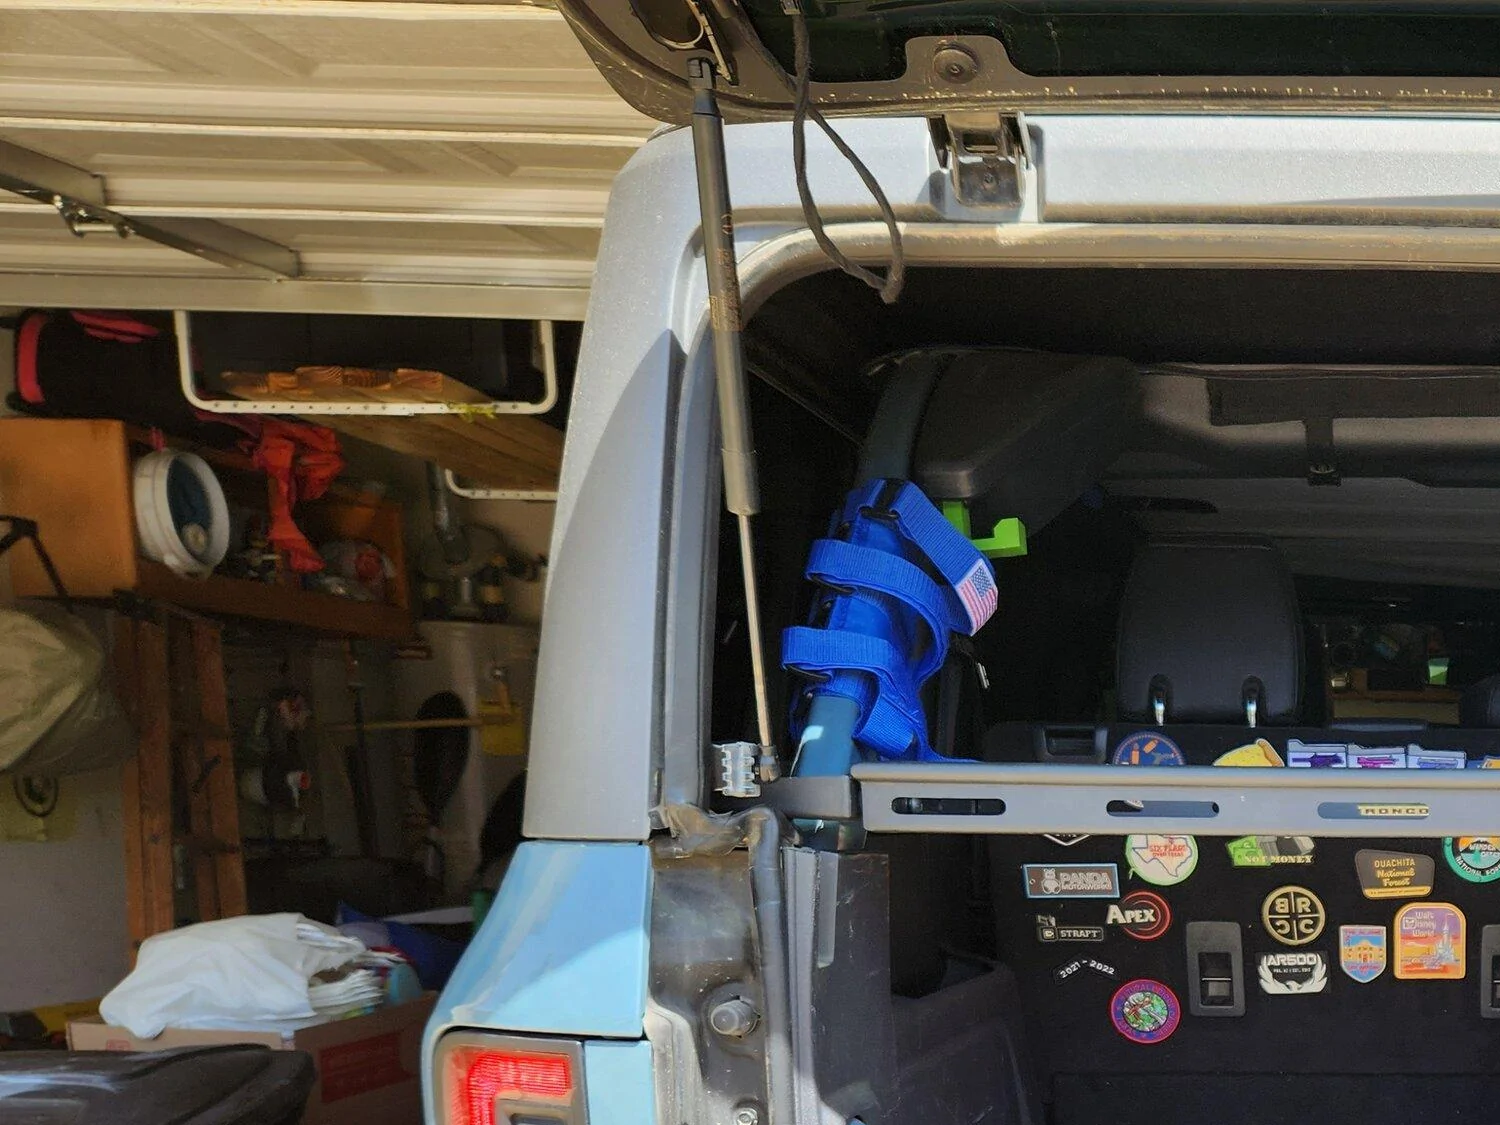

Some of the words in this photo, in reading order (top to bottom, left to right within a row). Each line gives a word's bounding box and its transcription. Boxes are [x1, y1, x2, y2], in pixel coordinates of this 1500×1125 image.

[1244, 855, 1268, 864] NOT
[1270, 855, 1313, 864] MONEY
[1374, 858, 1416, 868] OUACHITA
[1455, 856, 1482, 876] NATIONAL
[1060, 872, 1111, 883] PANDA
[1377, 868, 1416, 879] National
[1382, 877, 1412, 887] Forest
[1415, 911, 1434, 919] Walt
[1060, 929, 1098, 938] STRAPT
[1412, 929, 1435, 937] World
[1267, 953, 1318, 967] AR500
[1059, 961, 1082, 979] 2021
[1089, 959, 1116, 976] 2022
